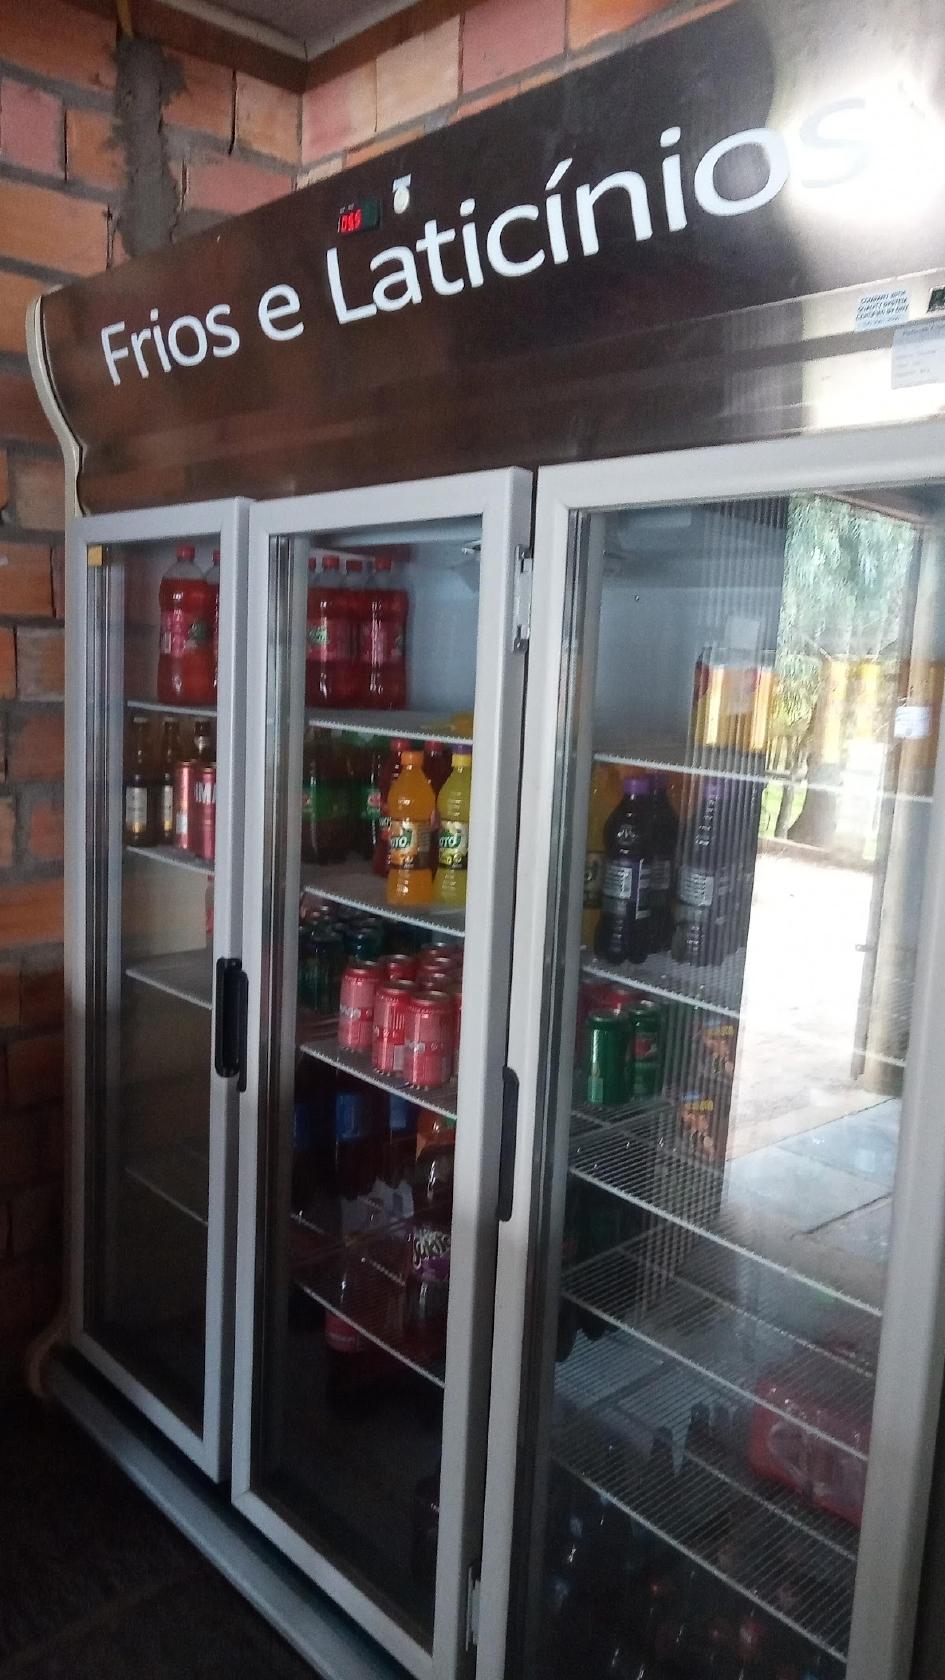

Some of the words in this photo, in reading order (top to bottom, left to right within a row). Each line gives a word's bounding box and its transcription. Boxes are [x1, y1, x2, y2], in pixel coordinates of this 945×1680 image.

[101, 303, 241, 387] Frios
[258, 283, 304, 342] e
[326, 97, 867, 325] Laticínios
